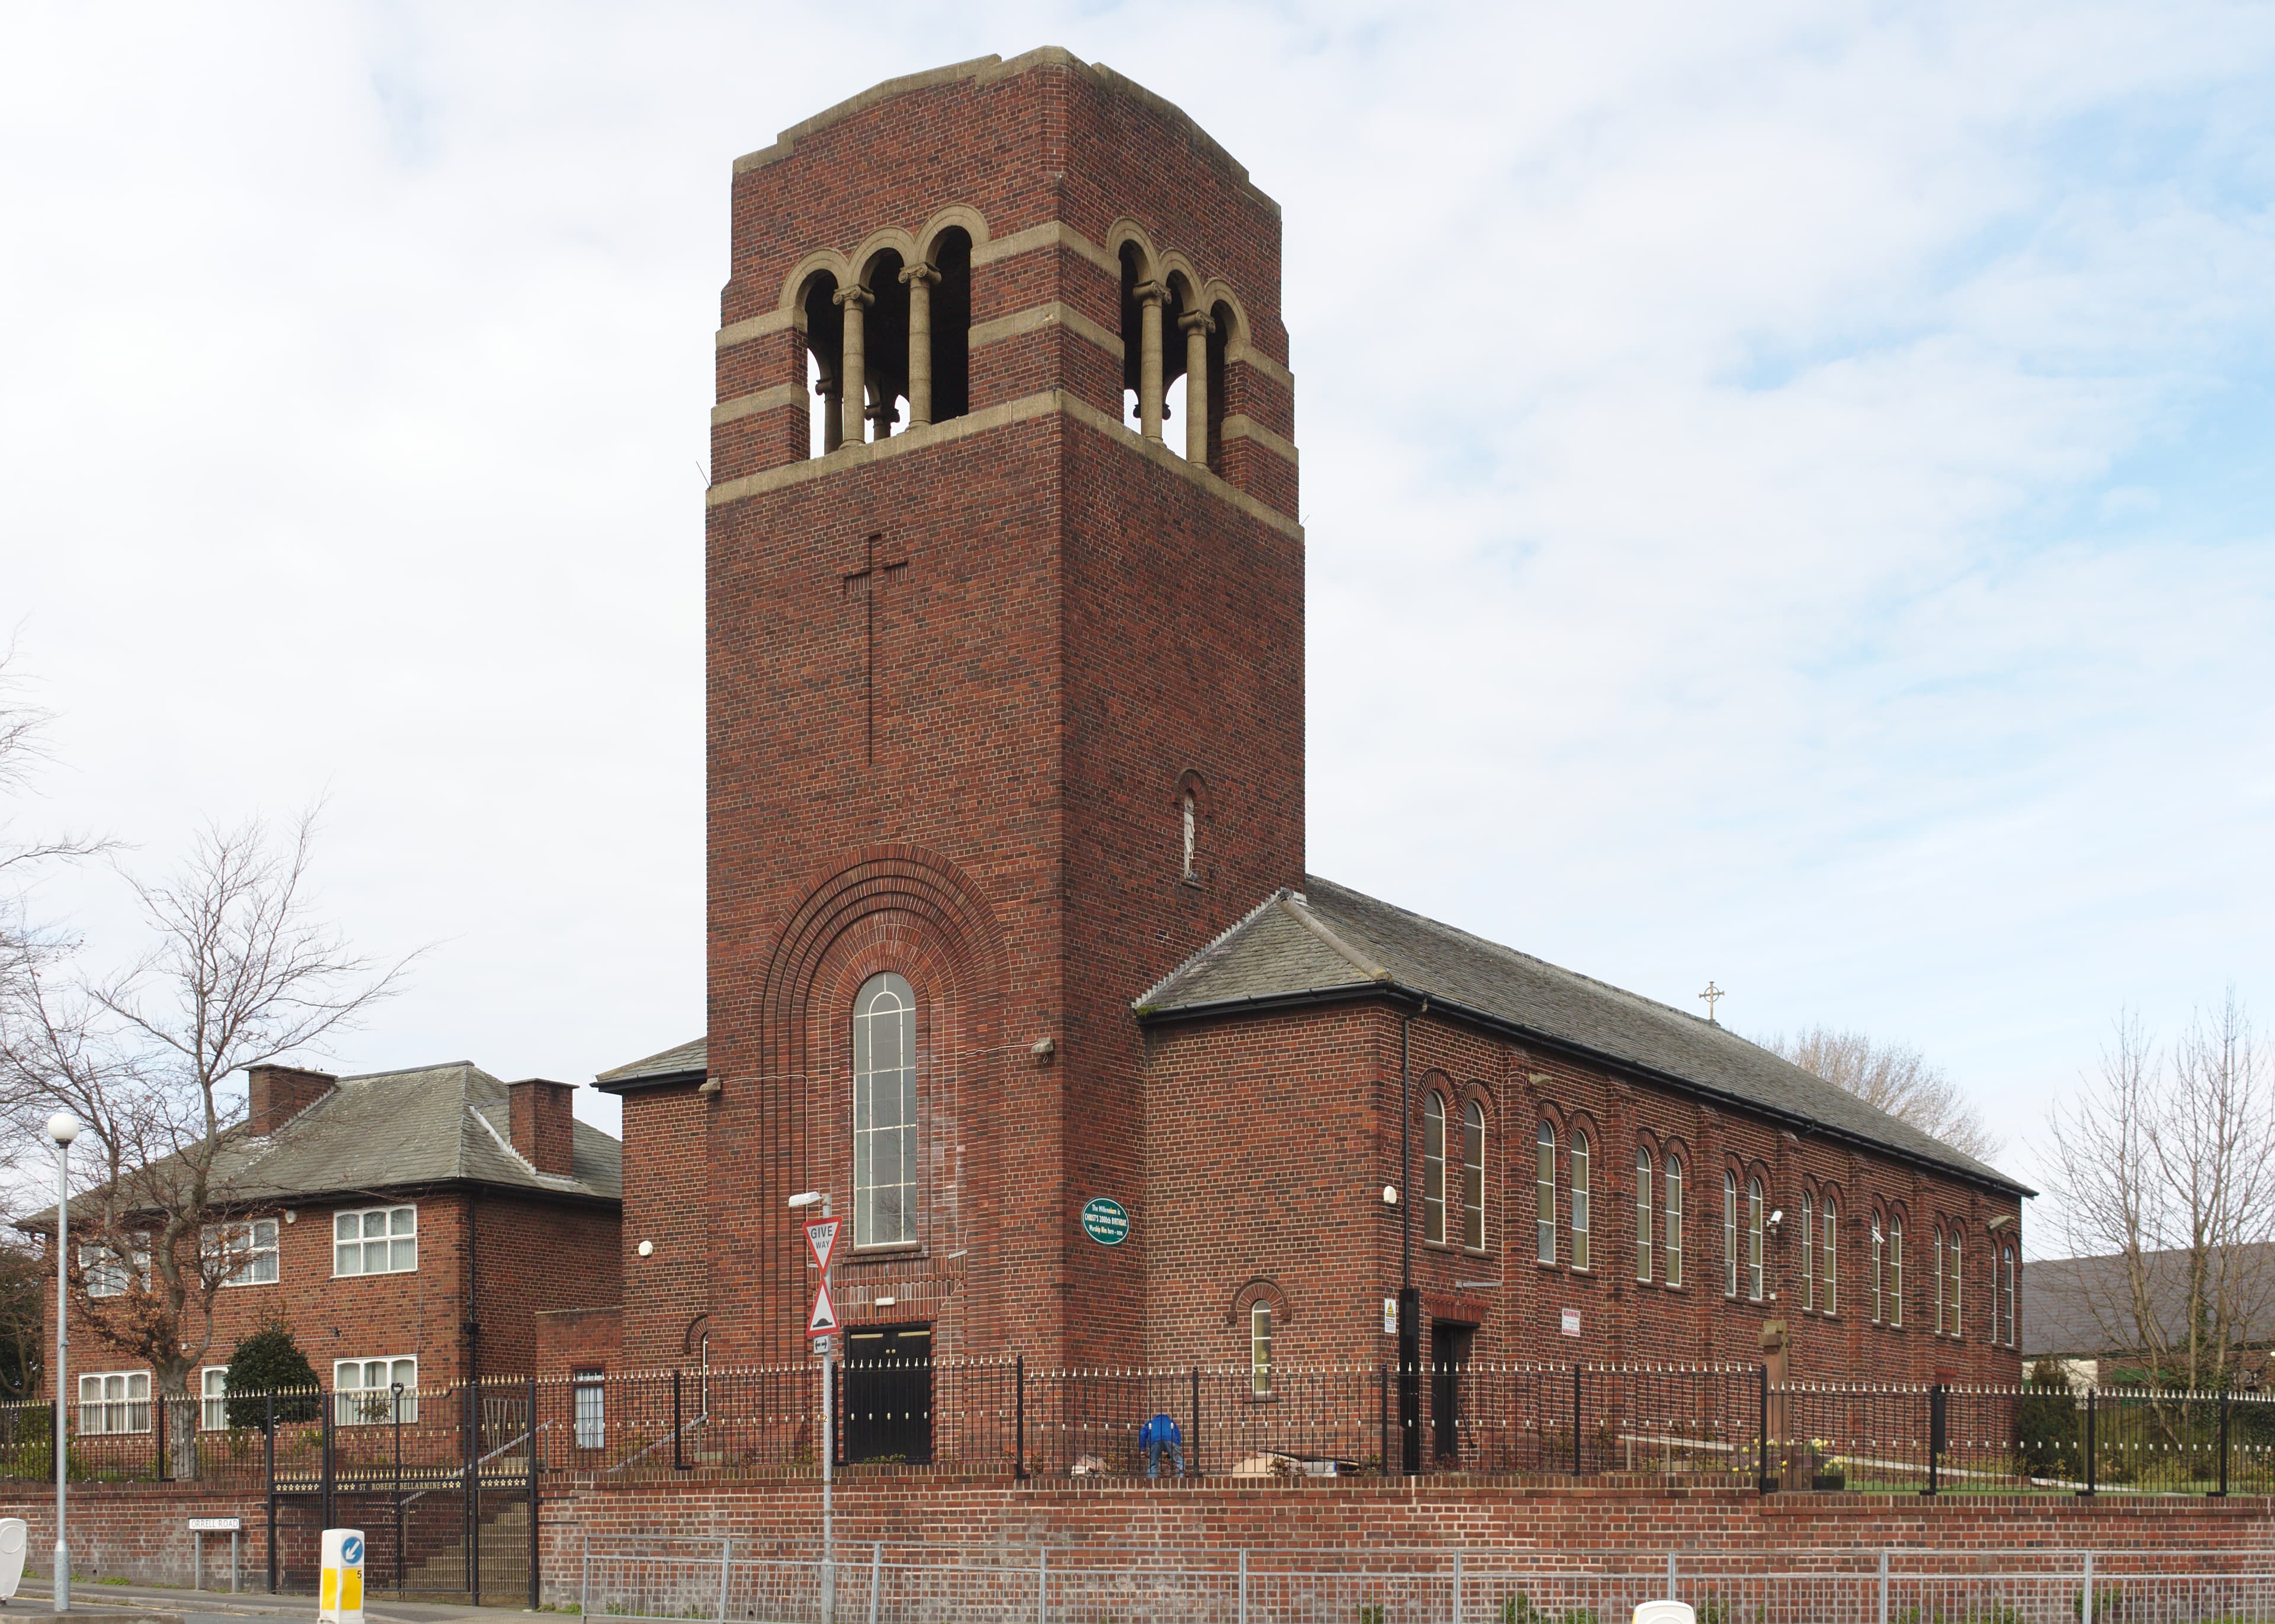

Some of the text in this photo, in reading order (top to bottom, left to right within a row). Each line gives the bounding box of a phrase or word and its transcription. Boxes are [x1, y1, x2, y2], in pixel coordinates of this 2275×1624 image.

[1099, 1205, 1117, 1215] Millennium
[1085, 1213, 1098, 1222] CHRIST'S
[1100, 1215, 1111, 1225] 2000th
[810, 1225, 833, 1239] GIVE
[1089, 1224, 1101, 1234] Worship
[816, 1240, 830, 1249] WAY
[371, 1482, 396, 1491] ROBERT
[399, 1481, 441, 1490] BELLARMINE
[219, 1519, 238, 1527] ROAD
[357, 1570, 362, 1579] 5
